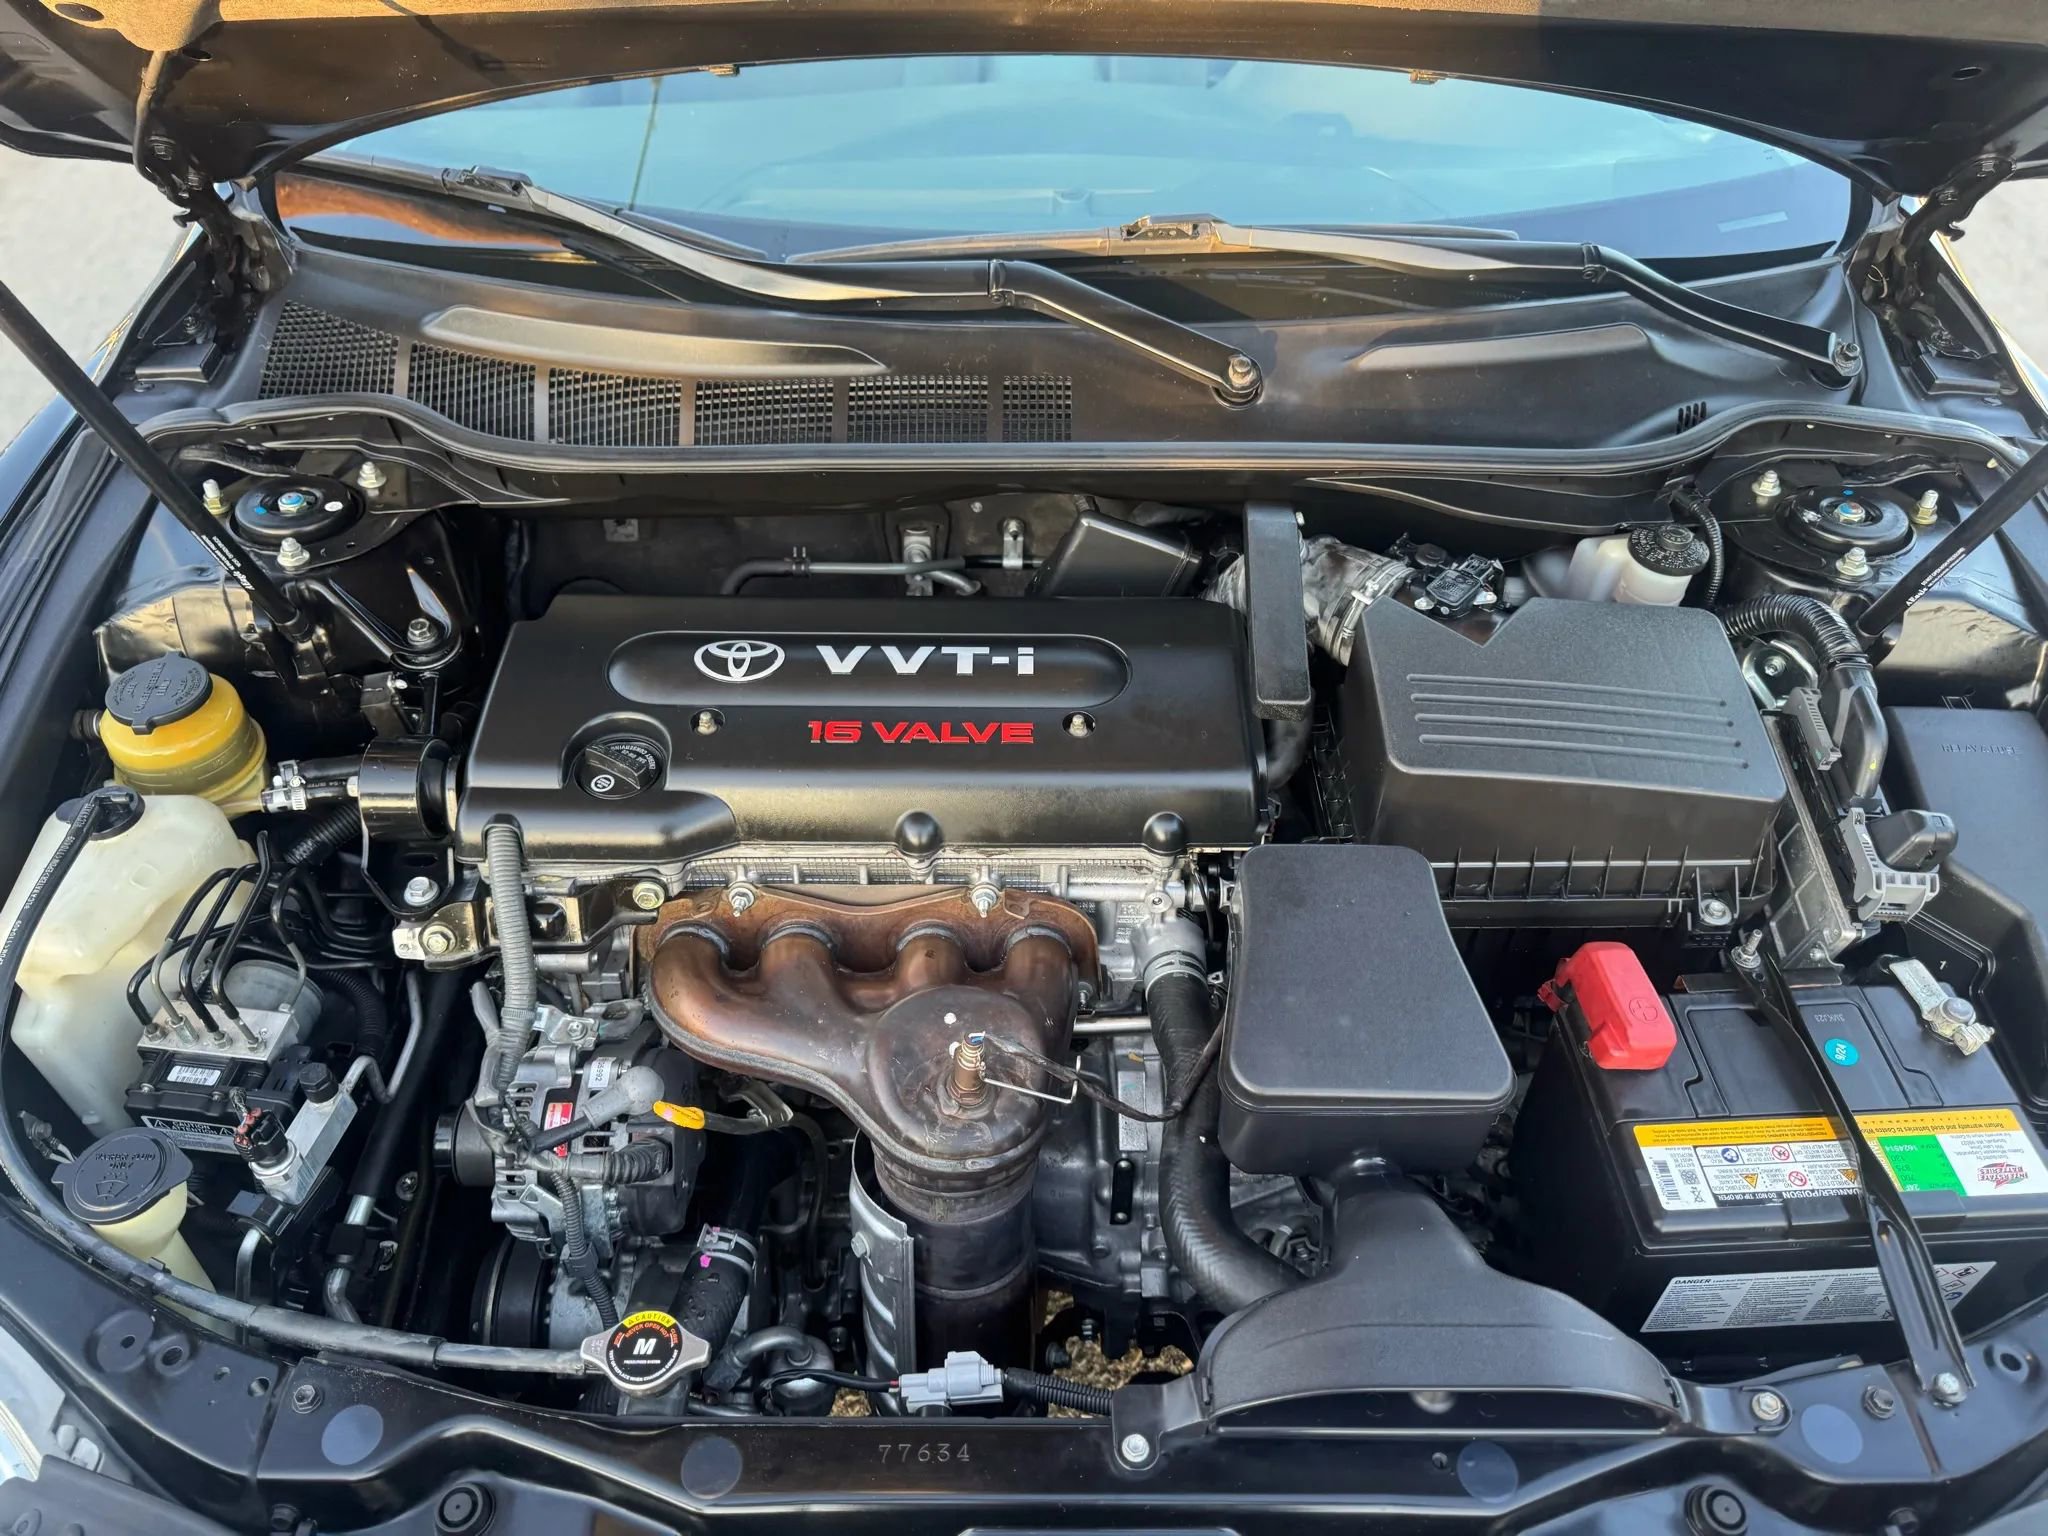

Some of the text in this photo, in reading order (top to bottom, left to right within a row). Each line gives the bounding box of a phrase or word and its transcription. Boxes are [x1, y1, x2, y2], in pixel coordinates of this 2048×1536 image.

[816, 645, 1034, 675] VVT-i
[808, 720, 1034, 745] 16 VALVE
[635, 1314, 671, 1324] CAUTION
[632, 1338, 657, 1355] M
[878, 1442, 971, 1465] 77634
